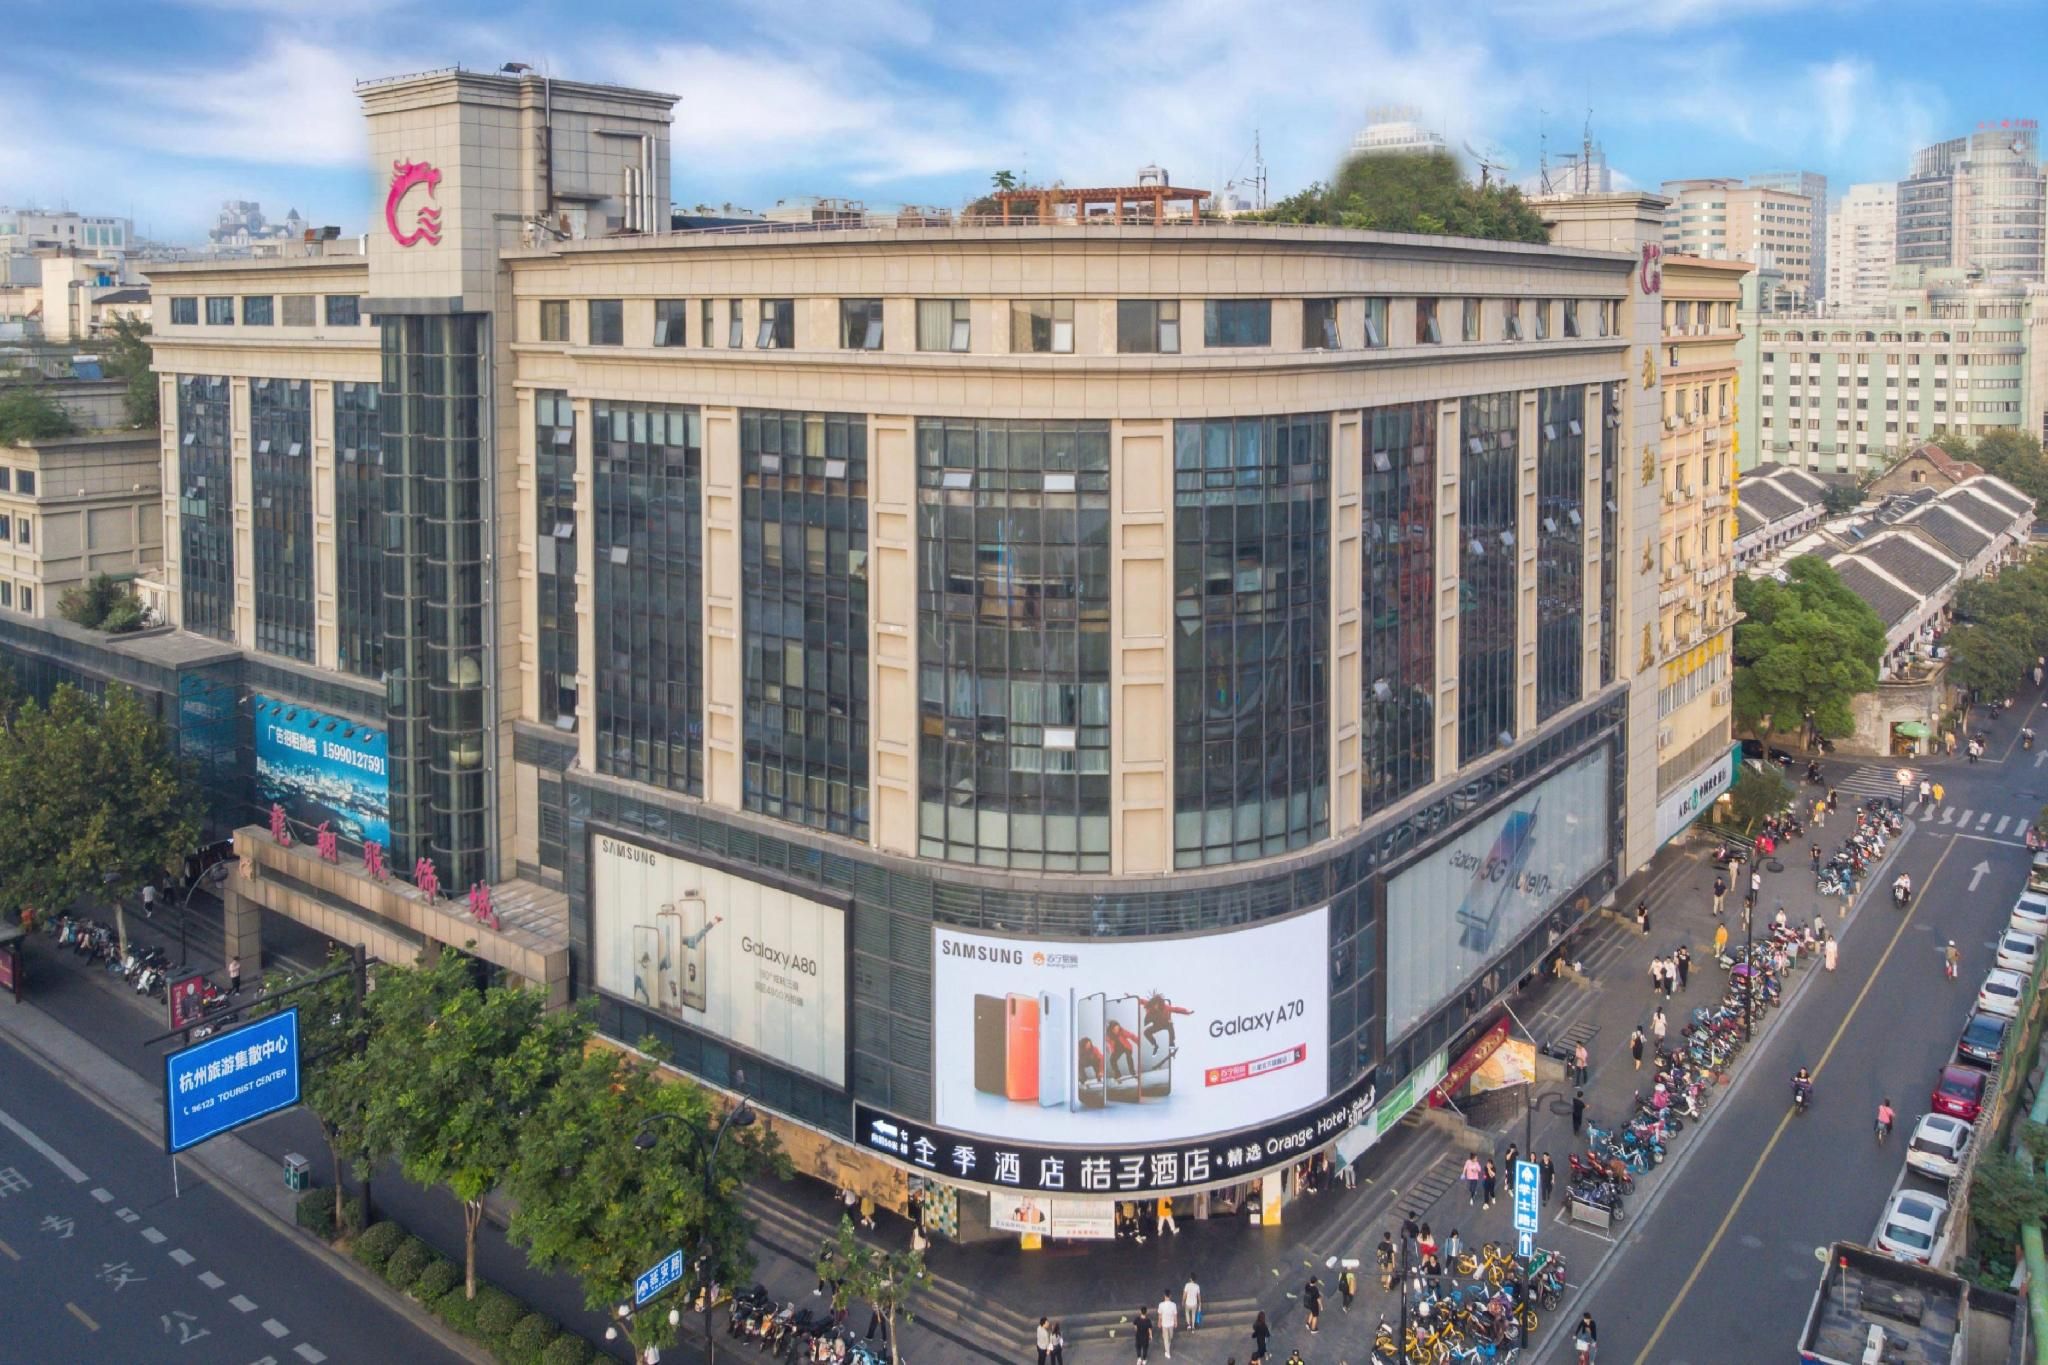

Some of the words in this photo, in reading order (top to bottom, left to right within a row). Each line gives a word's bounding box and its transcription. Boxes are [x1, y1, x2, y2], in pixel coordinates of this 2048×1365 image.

[322, 740, 386, 776] 15990127591
[602, 839, 657, 867] SAMSUNG
[741, 935, 790, 971] Galaxy
[790, 953, 817, 977] A80
[942, 939, 1024, 965] SAMSUNG
[1208, 1005, 1275, 1038] Galaxy
[1276, 998, 1304, 1025] A70
[179, 1034, 289, 1094] 杭州旅游集散中心
[191, 1098, 215, 1113] 96123
[217, 1080, 254, 1103] TOURIST
[255, 1068, 288, 1088] CENTER
[913, 1136, 1065, 1188] 全季酒店
[1267, 1126, 1314, 1155] Orange
